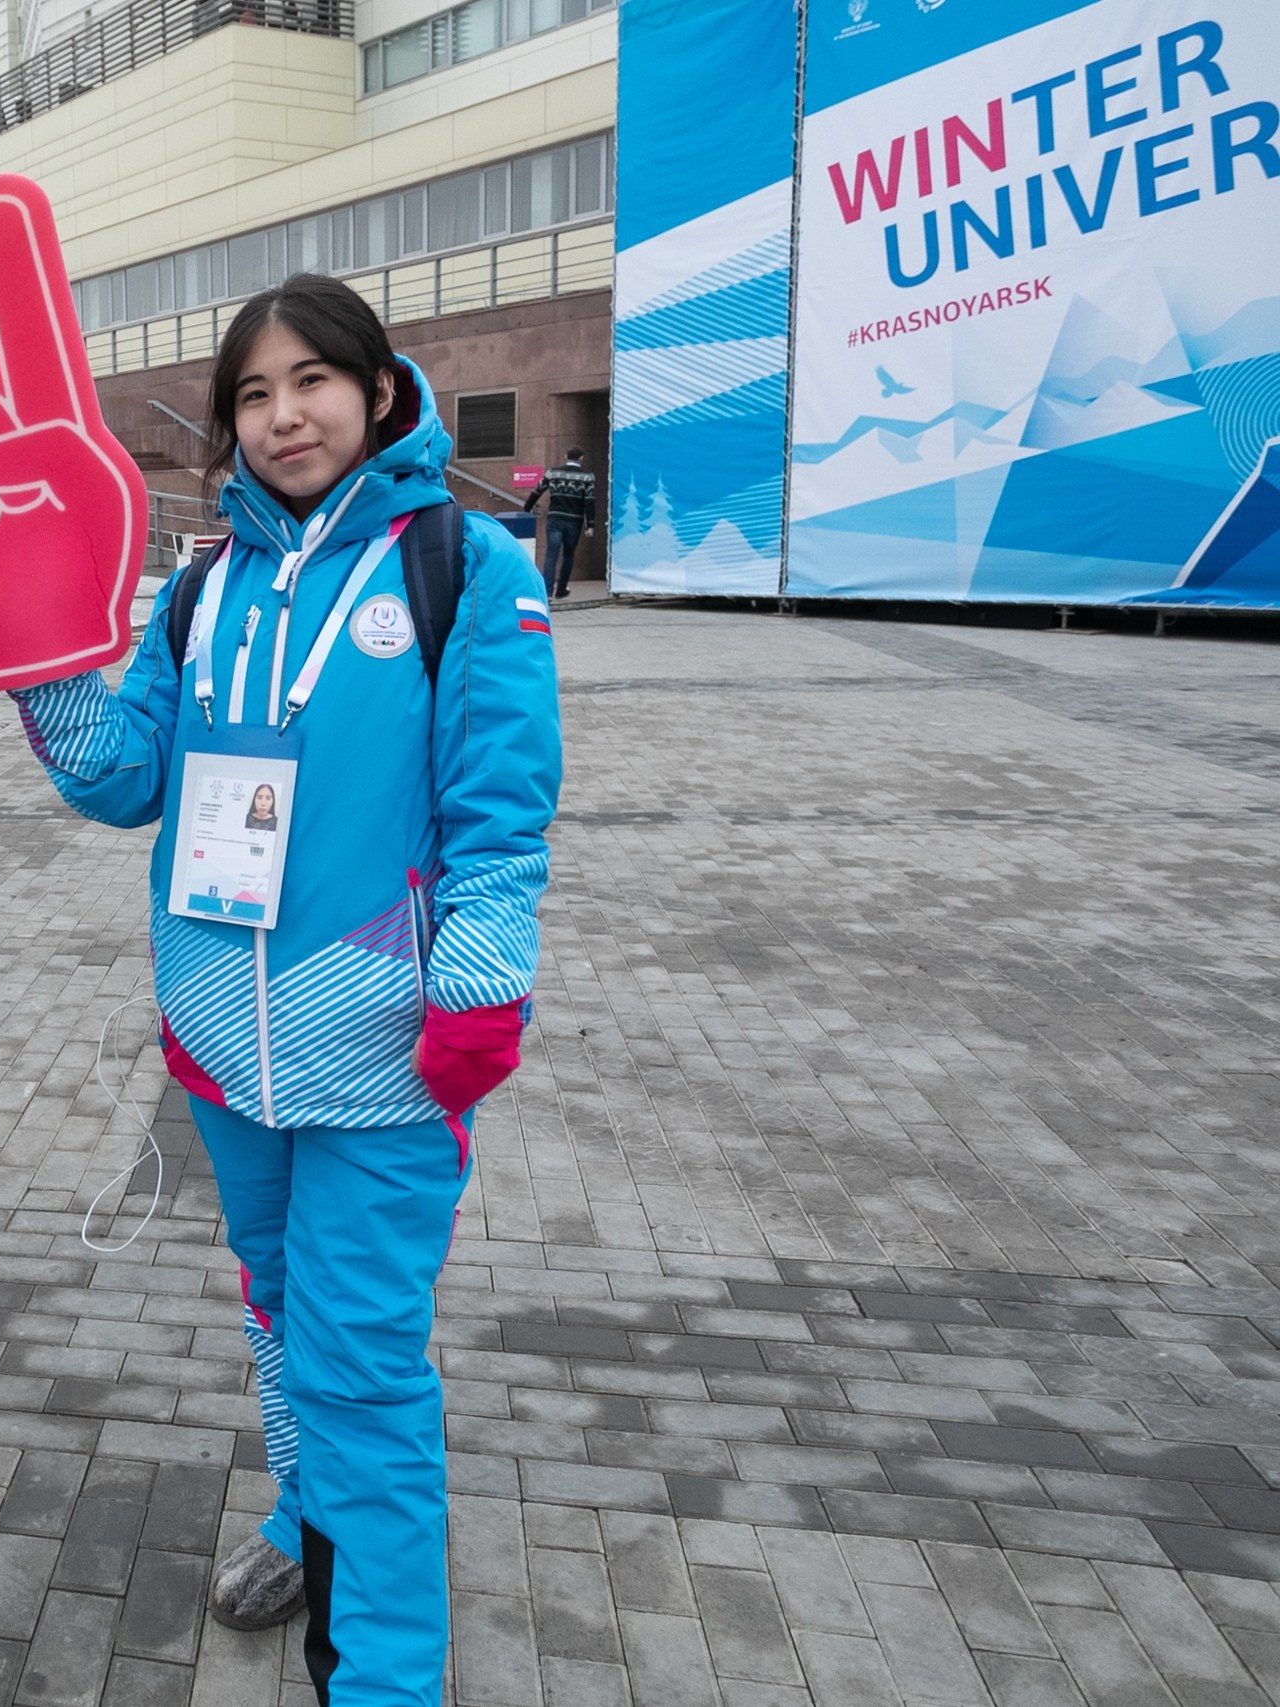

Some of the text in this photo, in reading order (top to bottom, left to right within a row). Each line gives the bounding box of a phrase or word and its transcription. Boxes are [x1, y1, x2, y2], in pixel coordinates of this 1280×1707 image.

[827, 20, 1231, 225] WINTER
[884, 101, 1280, 288] UNIVER
[847, 276, 1053, 349] #KRASNOYARSK
[221, 899, 233, 914] V
